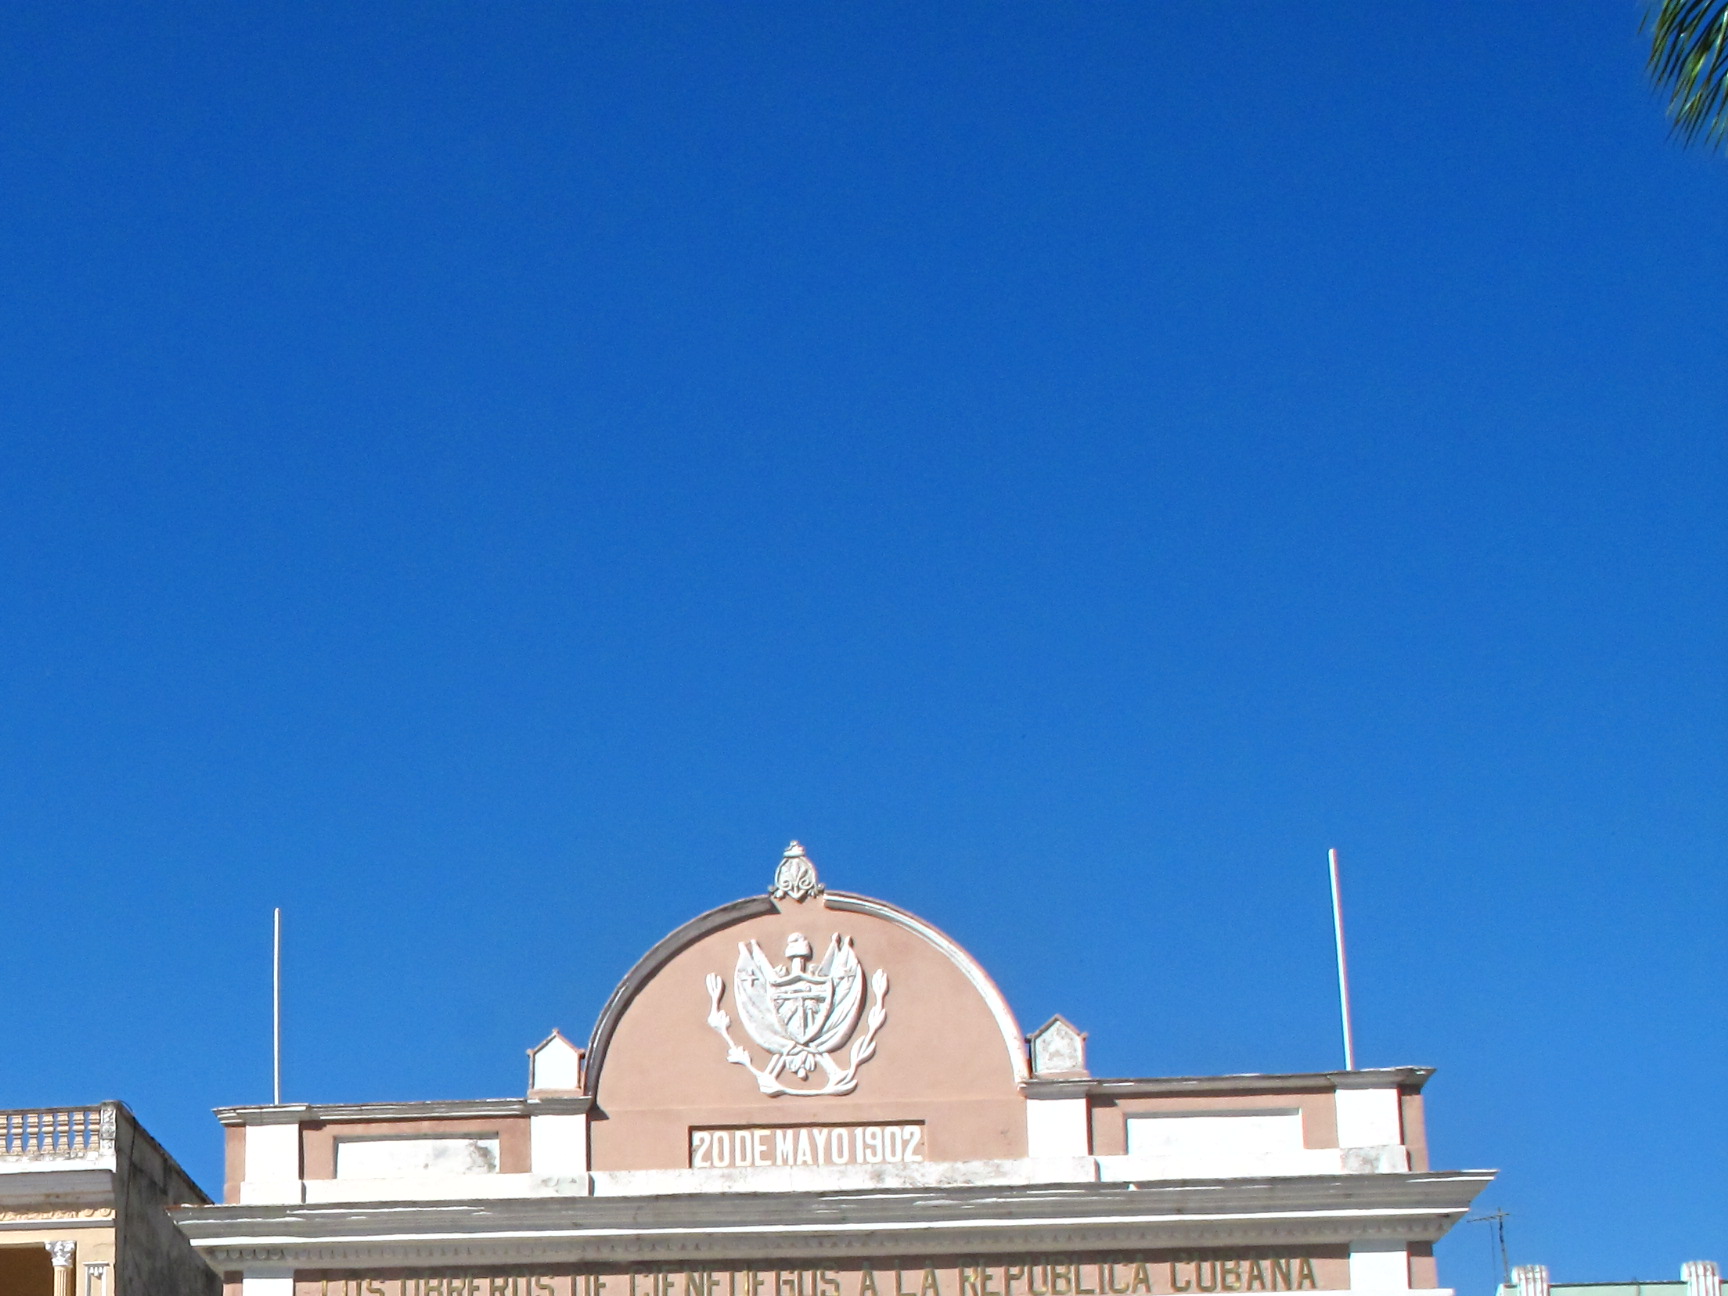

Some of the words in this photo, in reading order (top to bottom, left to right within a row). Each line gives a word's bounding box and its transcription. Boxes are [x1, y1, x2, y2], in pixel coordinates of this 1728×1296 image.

[692, 1131, 730, 1168] 20
[734, 1129, 772, 1167] DE
[775, 1127, 849, 1166] MAYO
[854, 1125, 924, 1164] 1902
[1168, 1248, 1317, 1293] CUBANA
